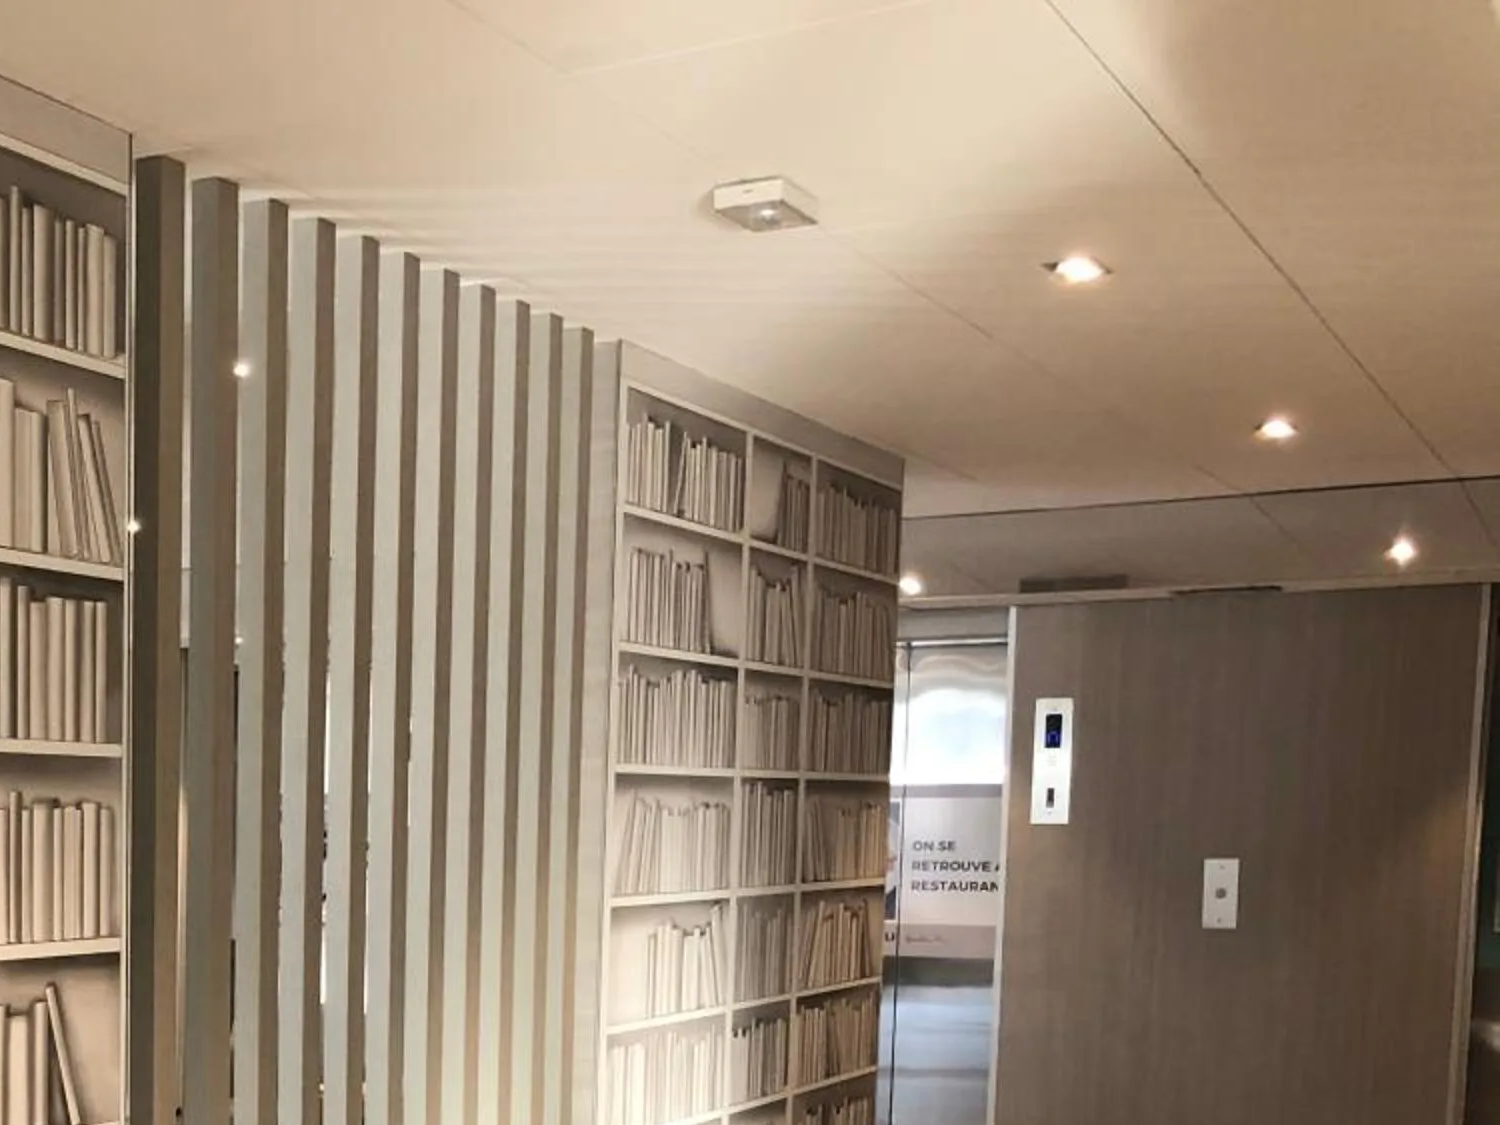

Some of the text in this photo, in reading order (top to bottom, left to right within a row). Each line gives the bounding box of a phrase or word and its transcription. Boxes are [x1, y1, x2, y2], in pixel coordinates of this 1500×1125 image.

[912, 840, 956, 851] ON SE
[911, 861, 991, 872] RETROUVE
